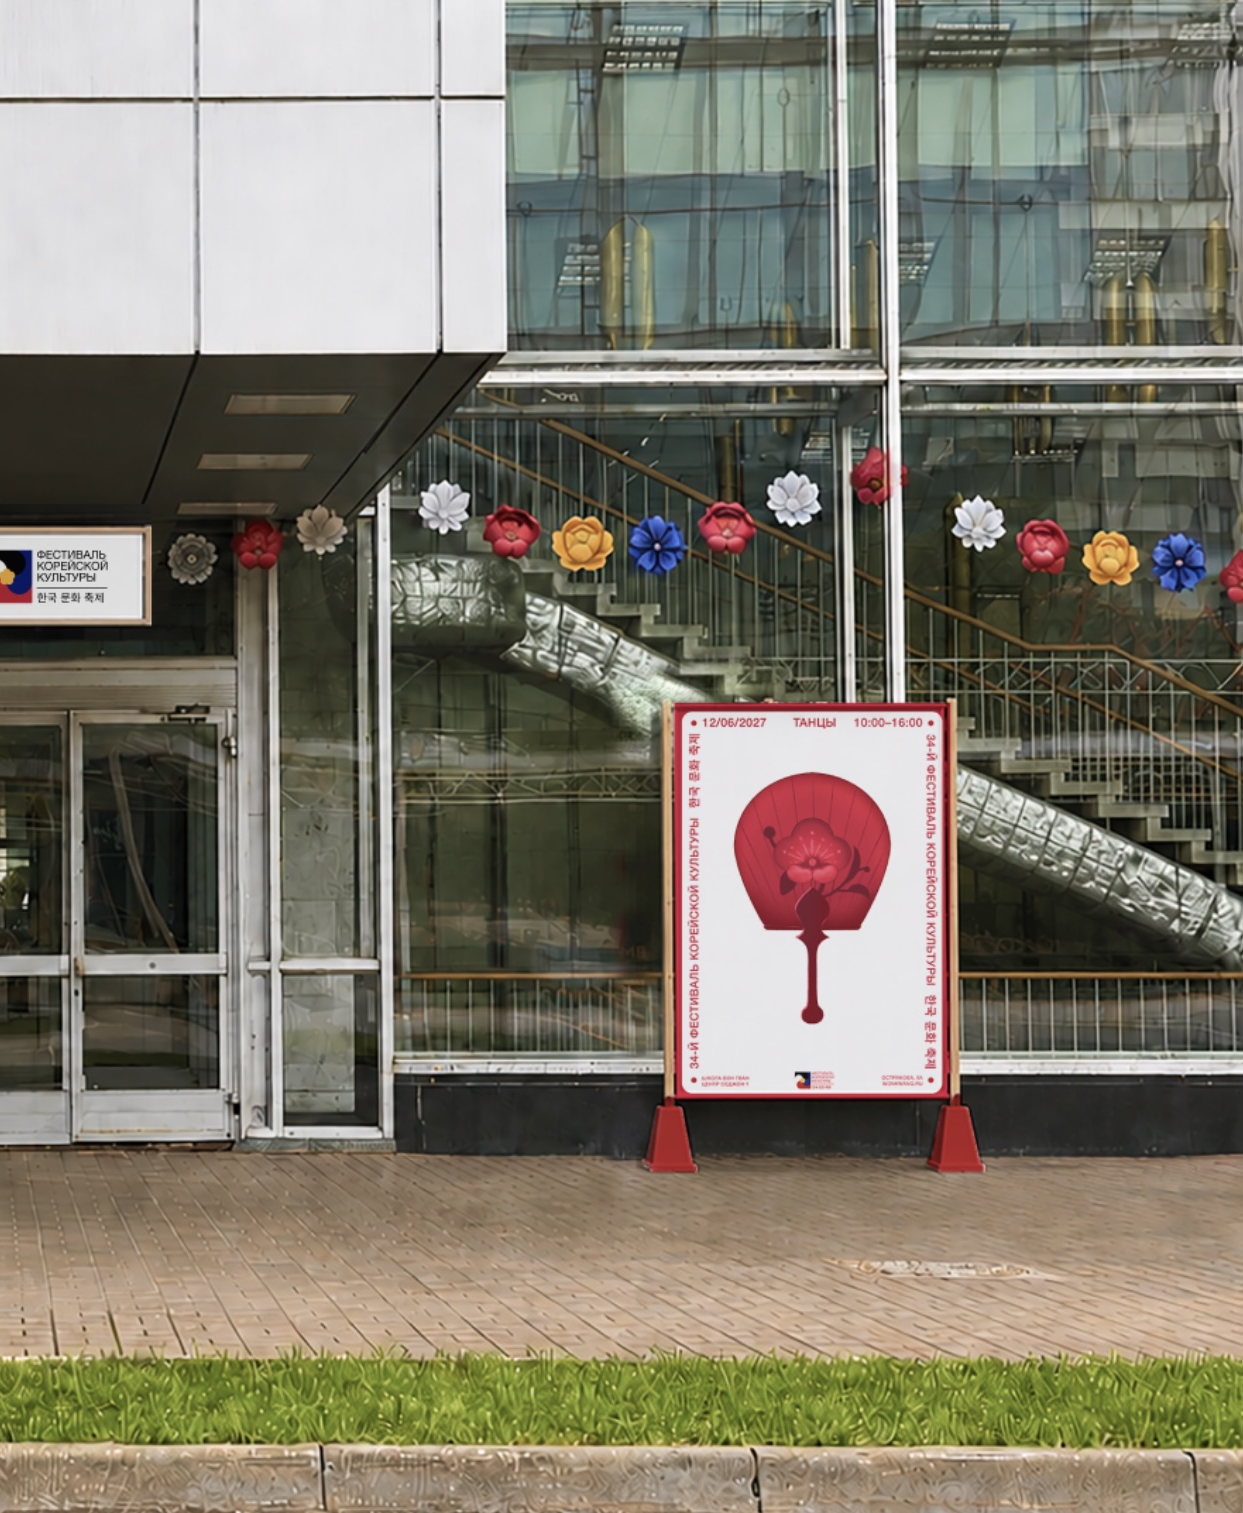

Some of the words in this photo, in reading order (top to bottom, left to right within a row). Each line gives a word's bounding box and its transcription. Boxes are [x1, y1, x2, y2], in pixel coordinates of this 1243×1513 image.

[37, 550, 106, 560] ФЕСТИВАЛЬ
[37, 559, 109, 571] КОРЕЙСКОЙ
[37, 572, 97, 583] КУЛЬТУРЫ
[37, 592, 57, 603] 한국
[61, 592, 81, 603] 문화
[84, 592, 104, 603] 축제
[702, 717, 767, 728] 12/06/2027
[793, 717, 837, 729] ТАНЦЫ
[926, 733, 938, 762] 34-Й
[689, 759, 701, 782] 문화
[689, 786, 701, 809] 한국
[925, 764, 937, 840] ФЕСТИВАЛЬ
[689, 817, 700, 882] КУЛЬТУРЫ
[925, 842, 938, 918] КОРЕЙСКОЙ
[687, 885, 700, 960] КОРЕЙСКОЙ
[925, 921, 937, 986] КУЛЬТУРЫ
[689, 963, 700, 1039] ФЕСТИВАЛЬ
[925, 995, 937, 1017] 한국
[925, 1021, 937, 1043] 문화
[687, 1041, 700, 1070] 34-Й
